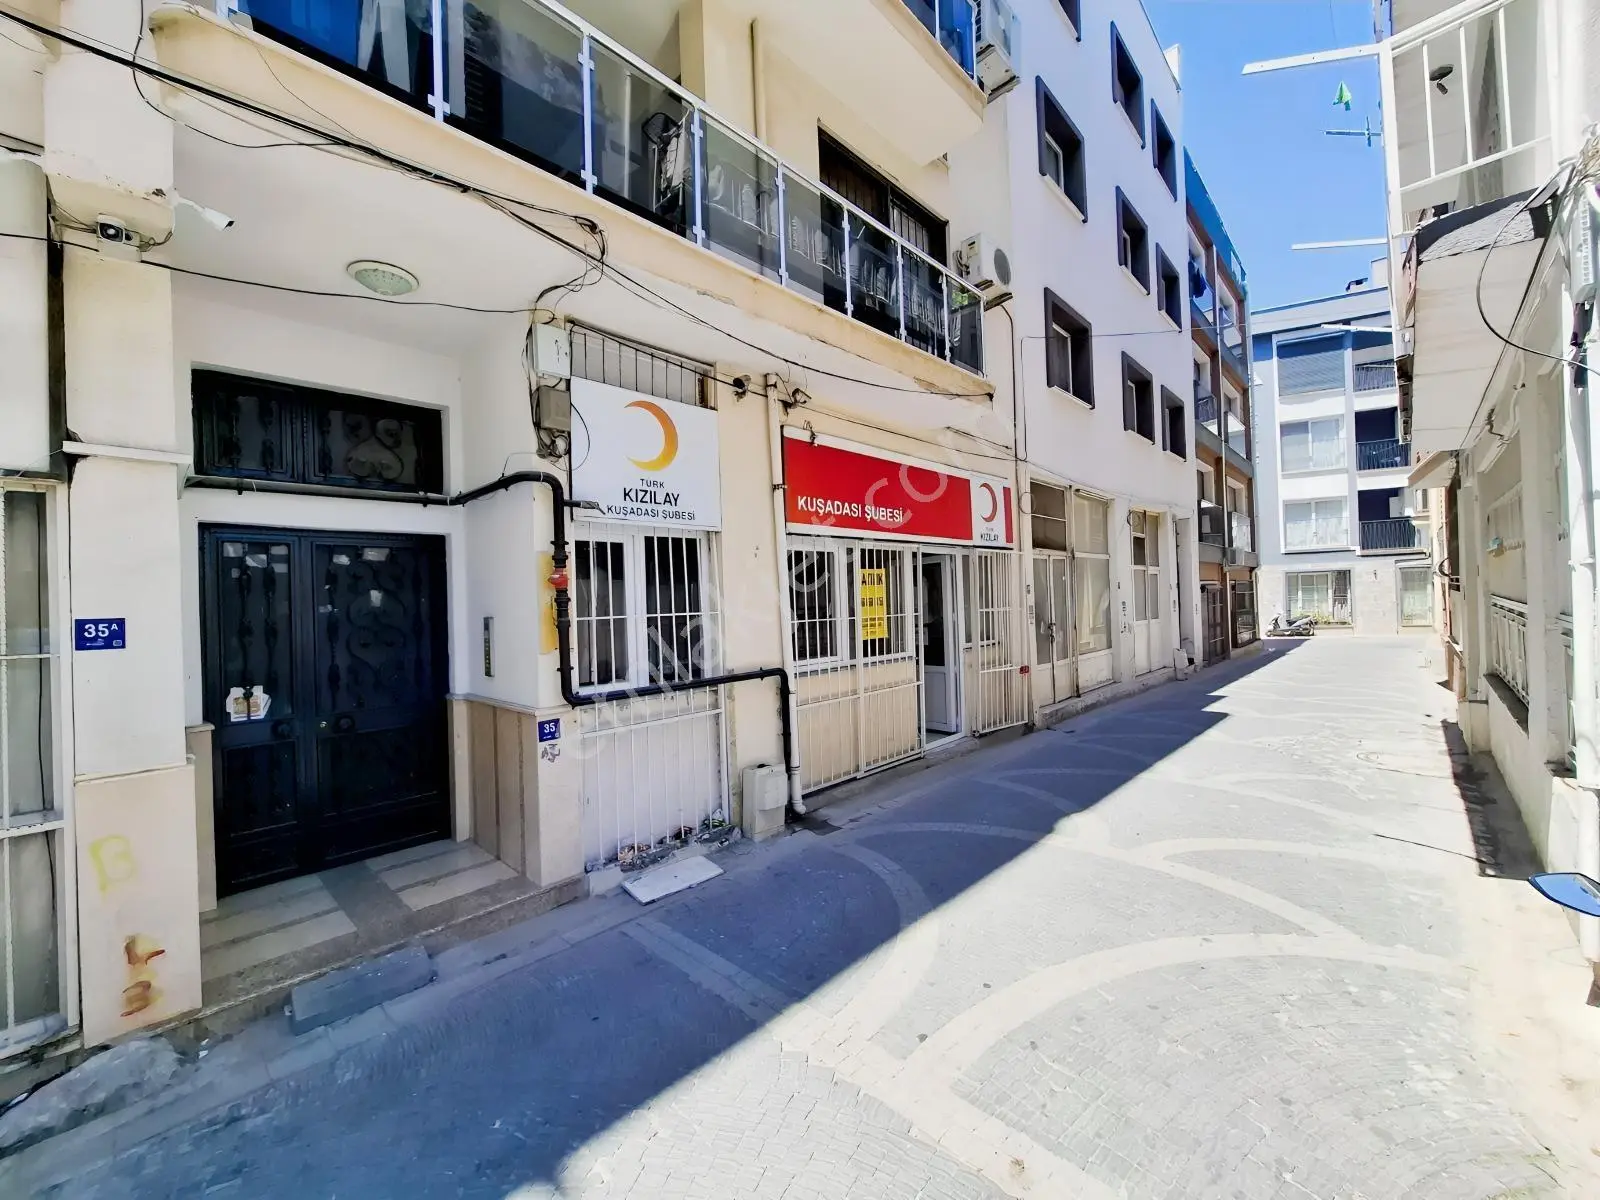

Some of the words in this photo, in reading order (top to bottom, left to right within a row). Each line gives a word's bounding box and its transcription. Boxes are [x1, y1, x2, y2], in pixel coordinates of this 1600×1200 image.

[623, 487, 680, 507] KIZILAY
[606, 504, 659, 518] KUŞADASI
[661, 509, 696, 521] ŞUBESİ
[797, 495, 862, 517] KUŞADASI
[864, 504, 903, 523] ŞUBESİ
[543, 722, 556, 733] 35
